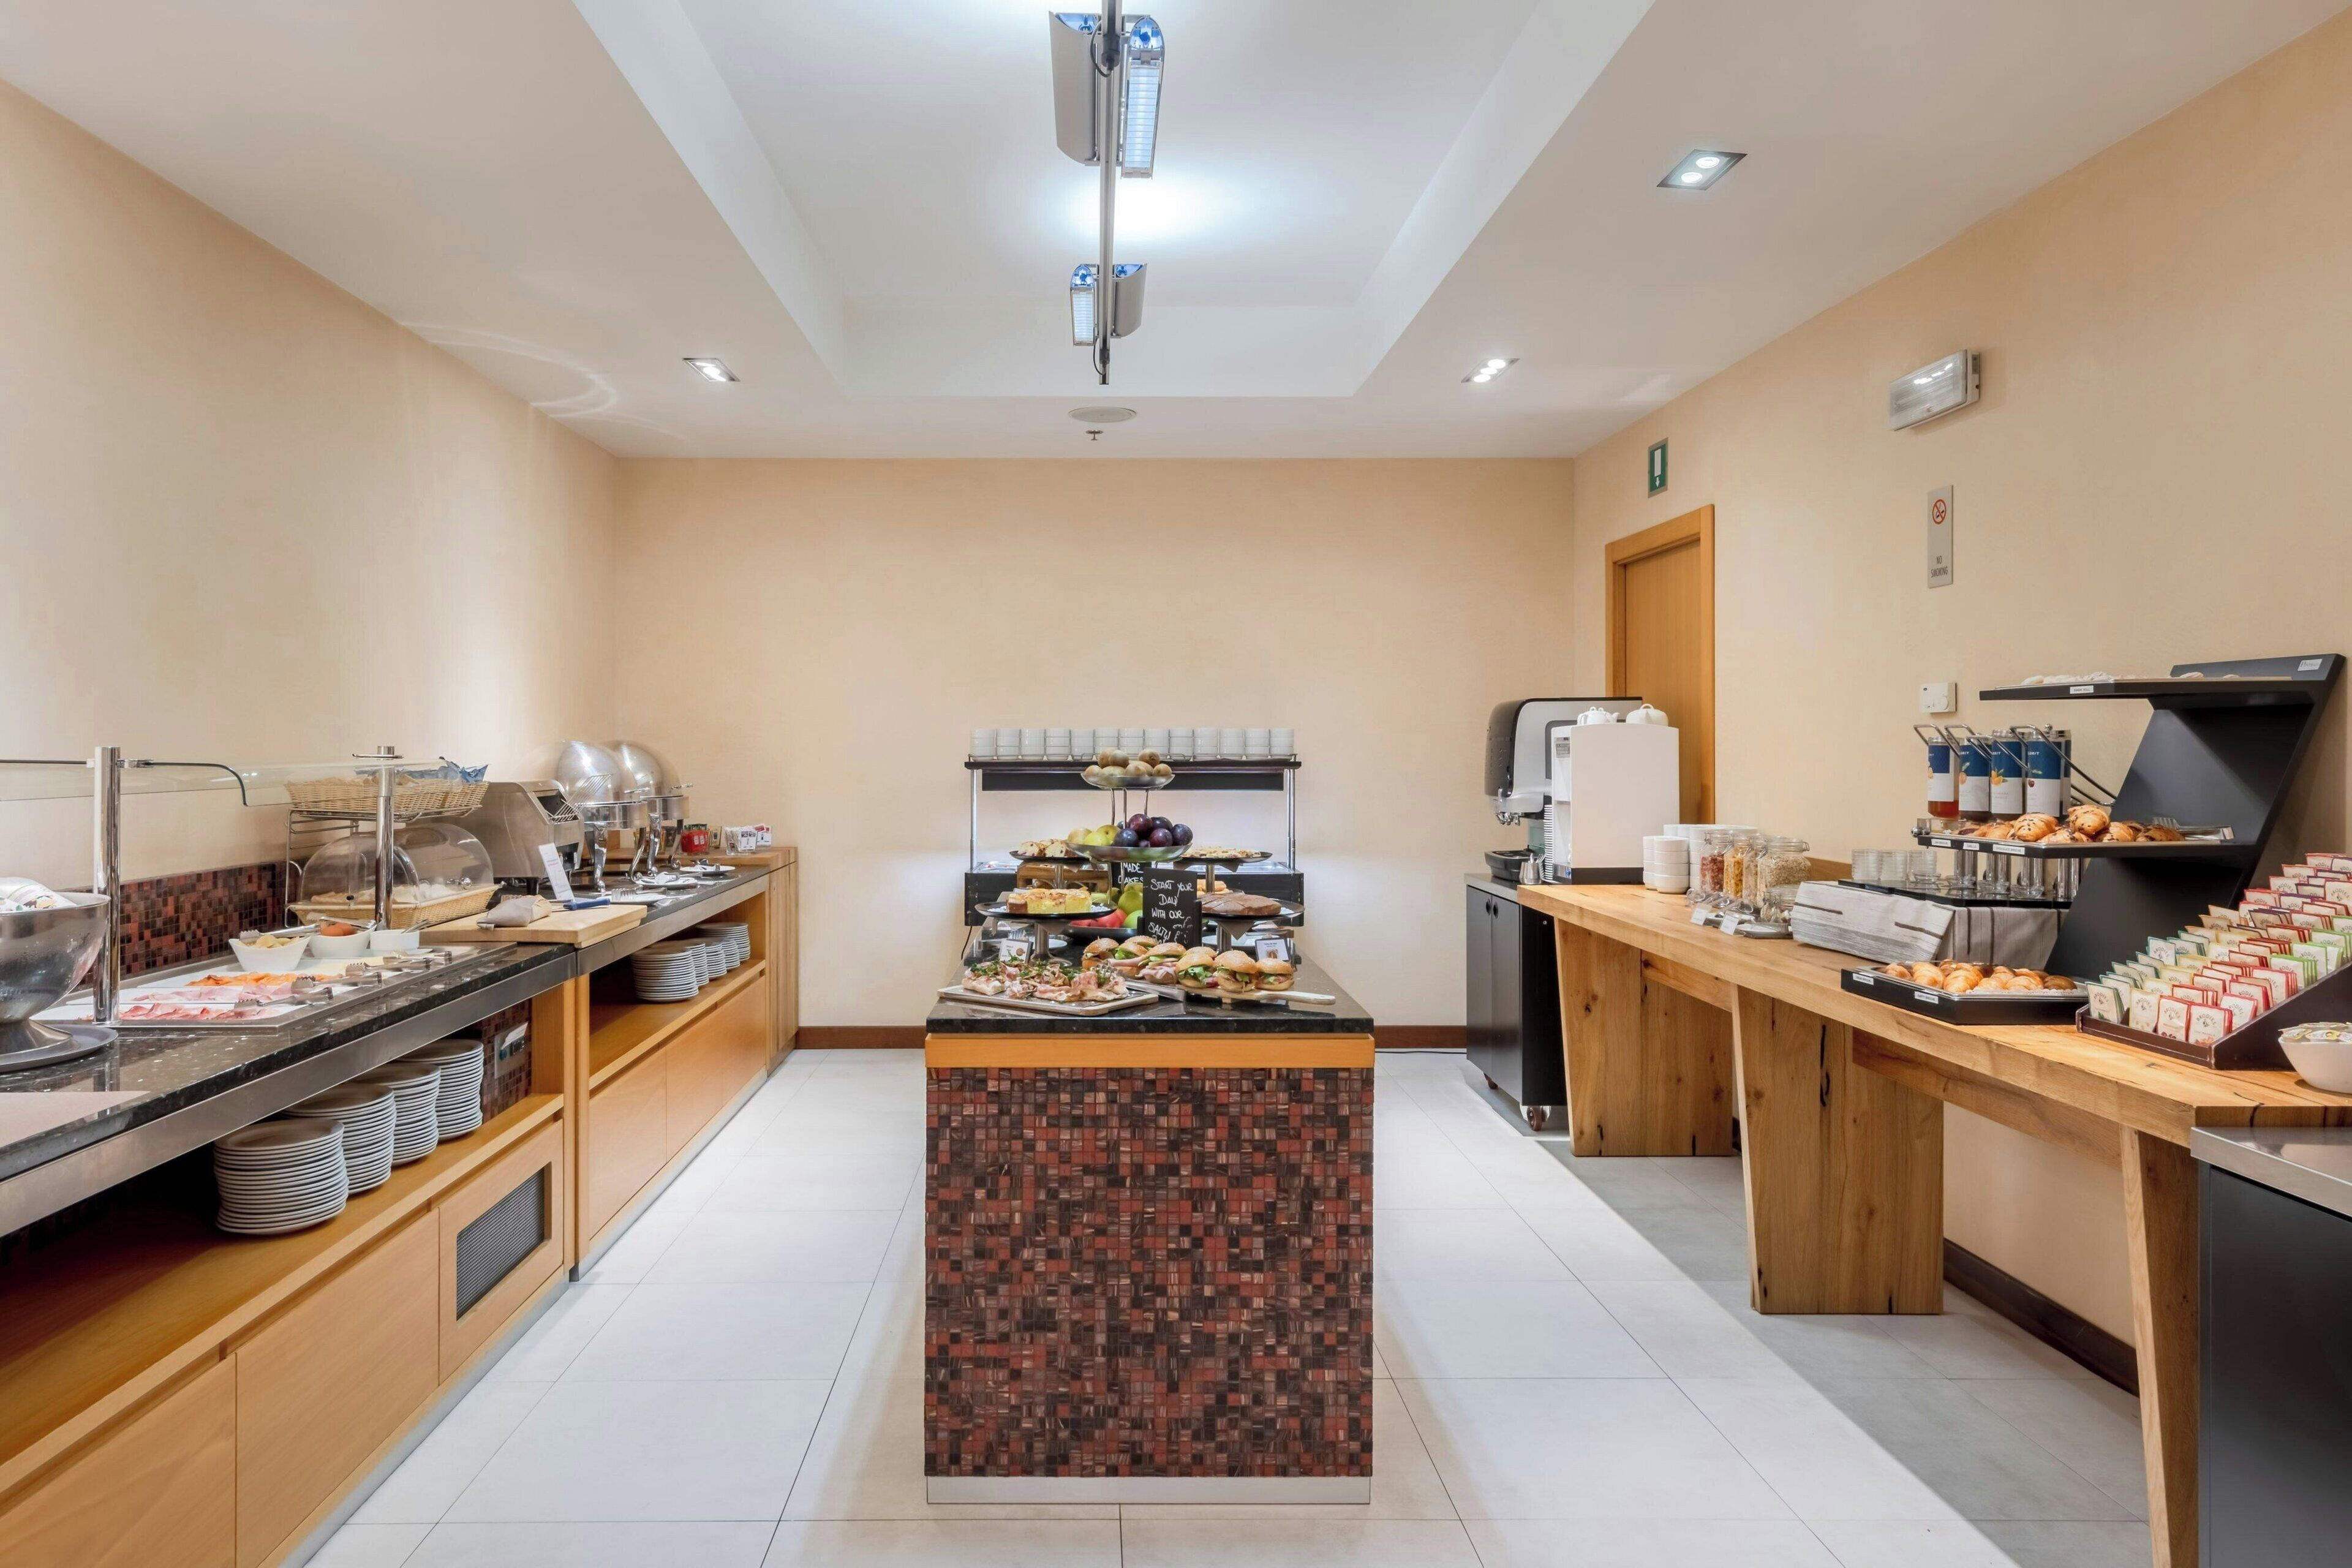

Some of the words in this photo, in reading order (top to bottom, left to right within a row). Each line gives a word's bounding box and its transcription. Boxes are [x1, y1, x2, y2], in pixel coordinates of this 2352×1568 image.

[1936, 556, 1943, 565] NO
[1931, 566, 1948, 578] SMOKING
[1123, 862, 1144, 873] MADE
[1151, 879, 1175, 890] START
[1177, 883, 1194, 897] YOUR
[1152, 907, 1166, 919] WITH
[1169, 910, 1185, 919] OUR
